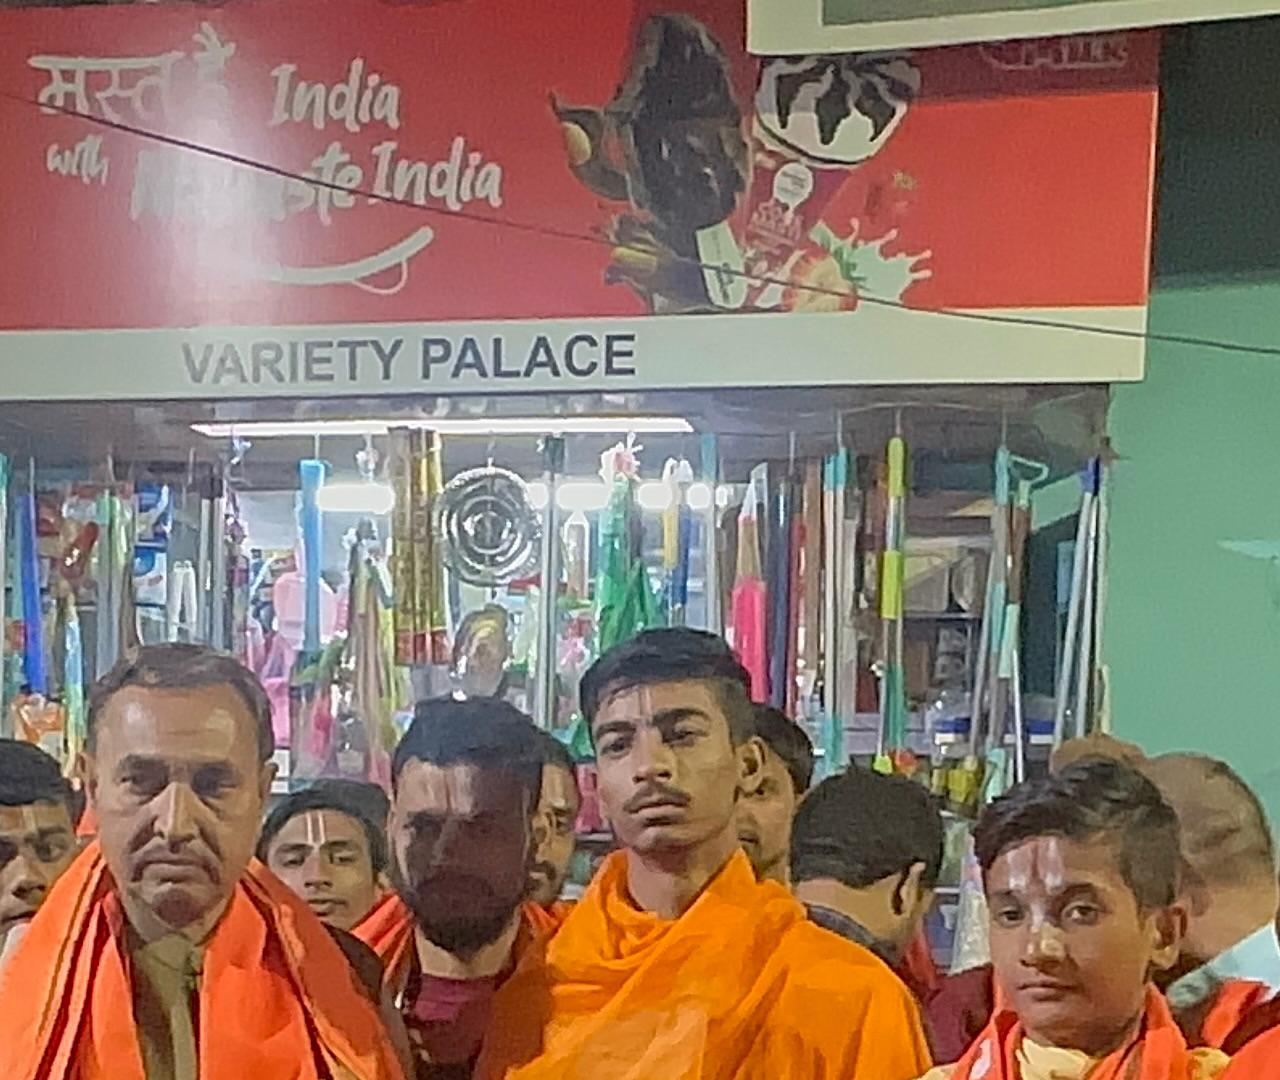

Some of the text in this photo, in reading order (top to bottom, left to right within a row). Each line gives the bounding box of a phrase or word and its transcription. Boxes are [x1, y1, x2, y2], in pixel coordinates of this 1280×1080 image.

[269, 57, 401, 132] India
[46, 133, 109, 185] with
[370, 135, 503, 211] India
[181, 332, 637, 384] VARIETY PALACE
